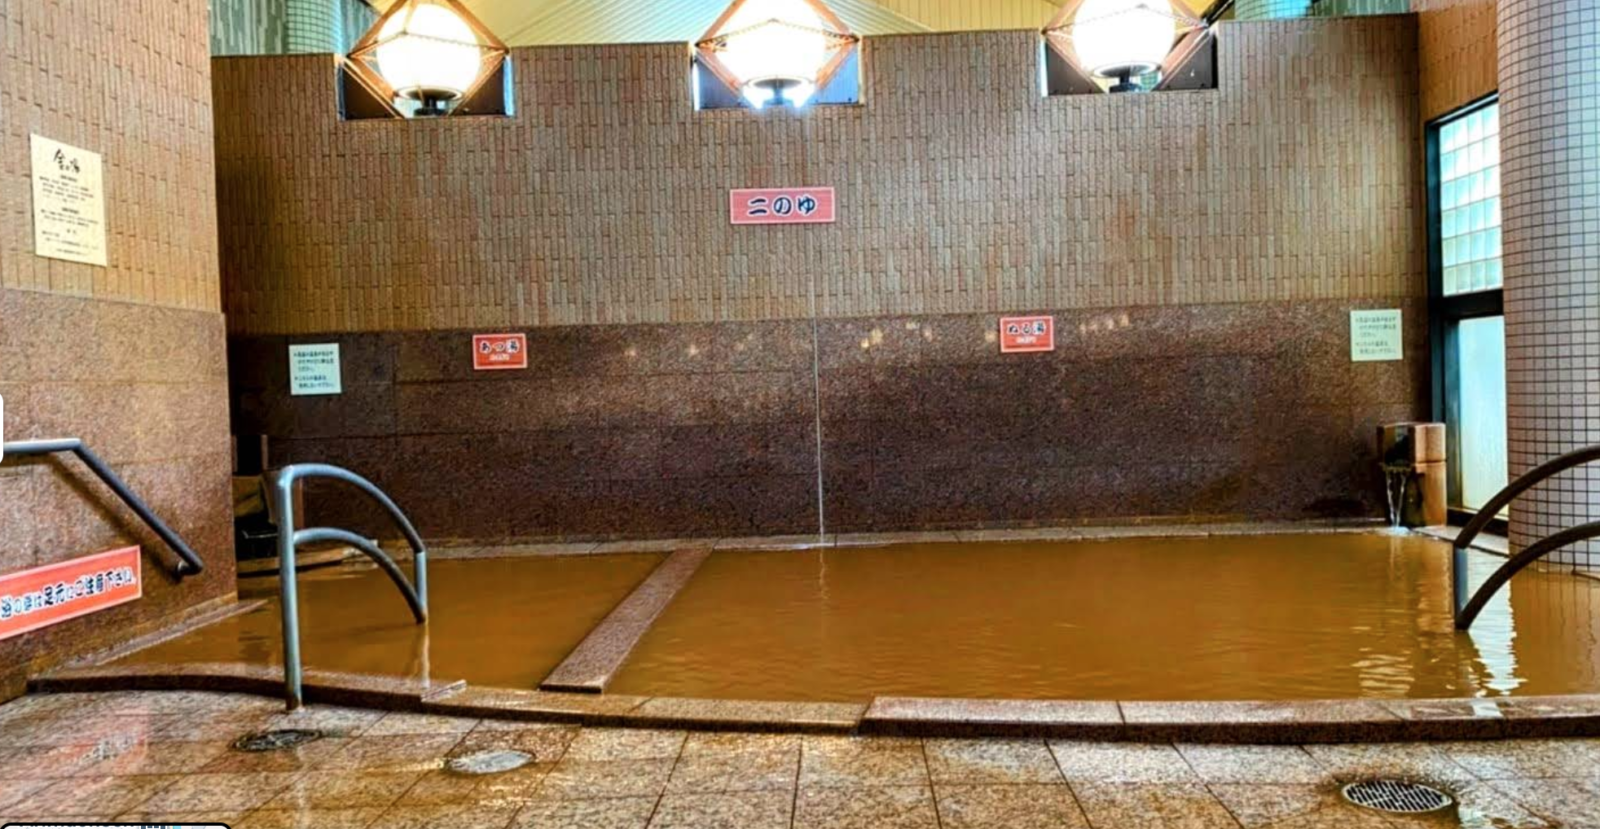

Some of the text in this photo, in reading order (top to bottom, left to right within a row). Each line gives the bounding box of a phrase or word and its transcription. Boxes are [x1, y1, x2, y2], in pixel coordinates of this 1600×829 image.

[748, 195, 817, 215] 二のゆ
[1007, 321, 1046, 335] ぬる湯
[480, 339, 519, 353] あつ湯
